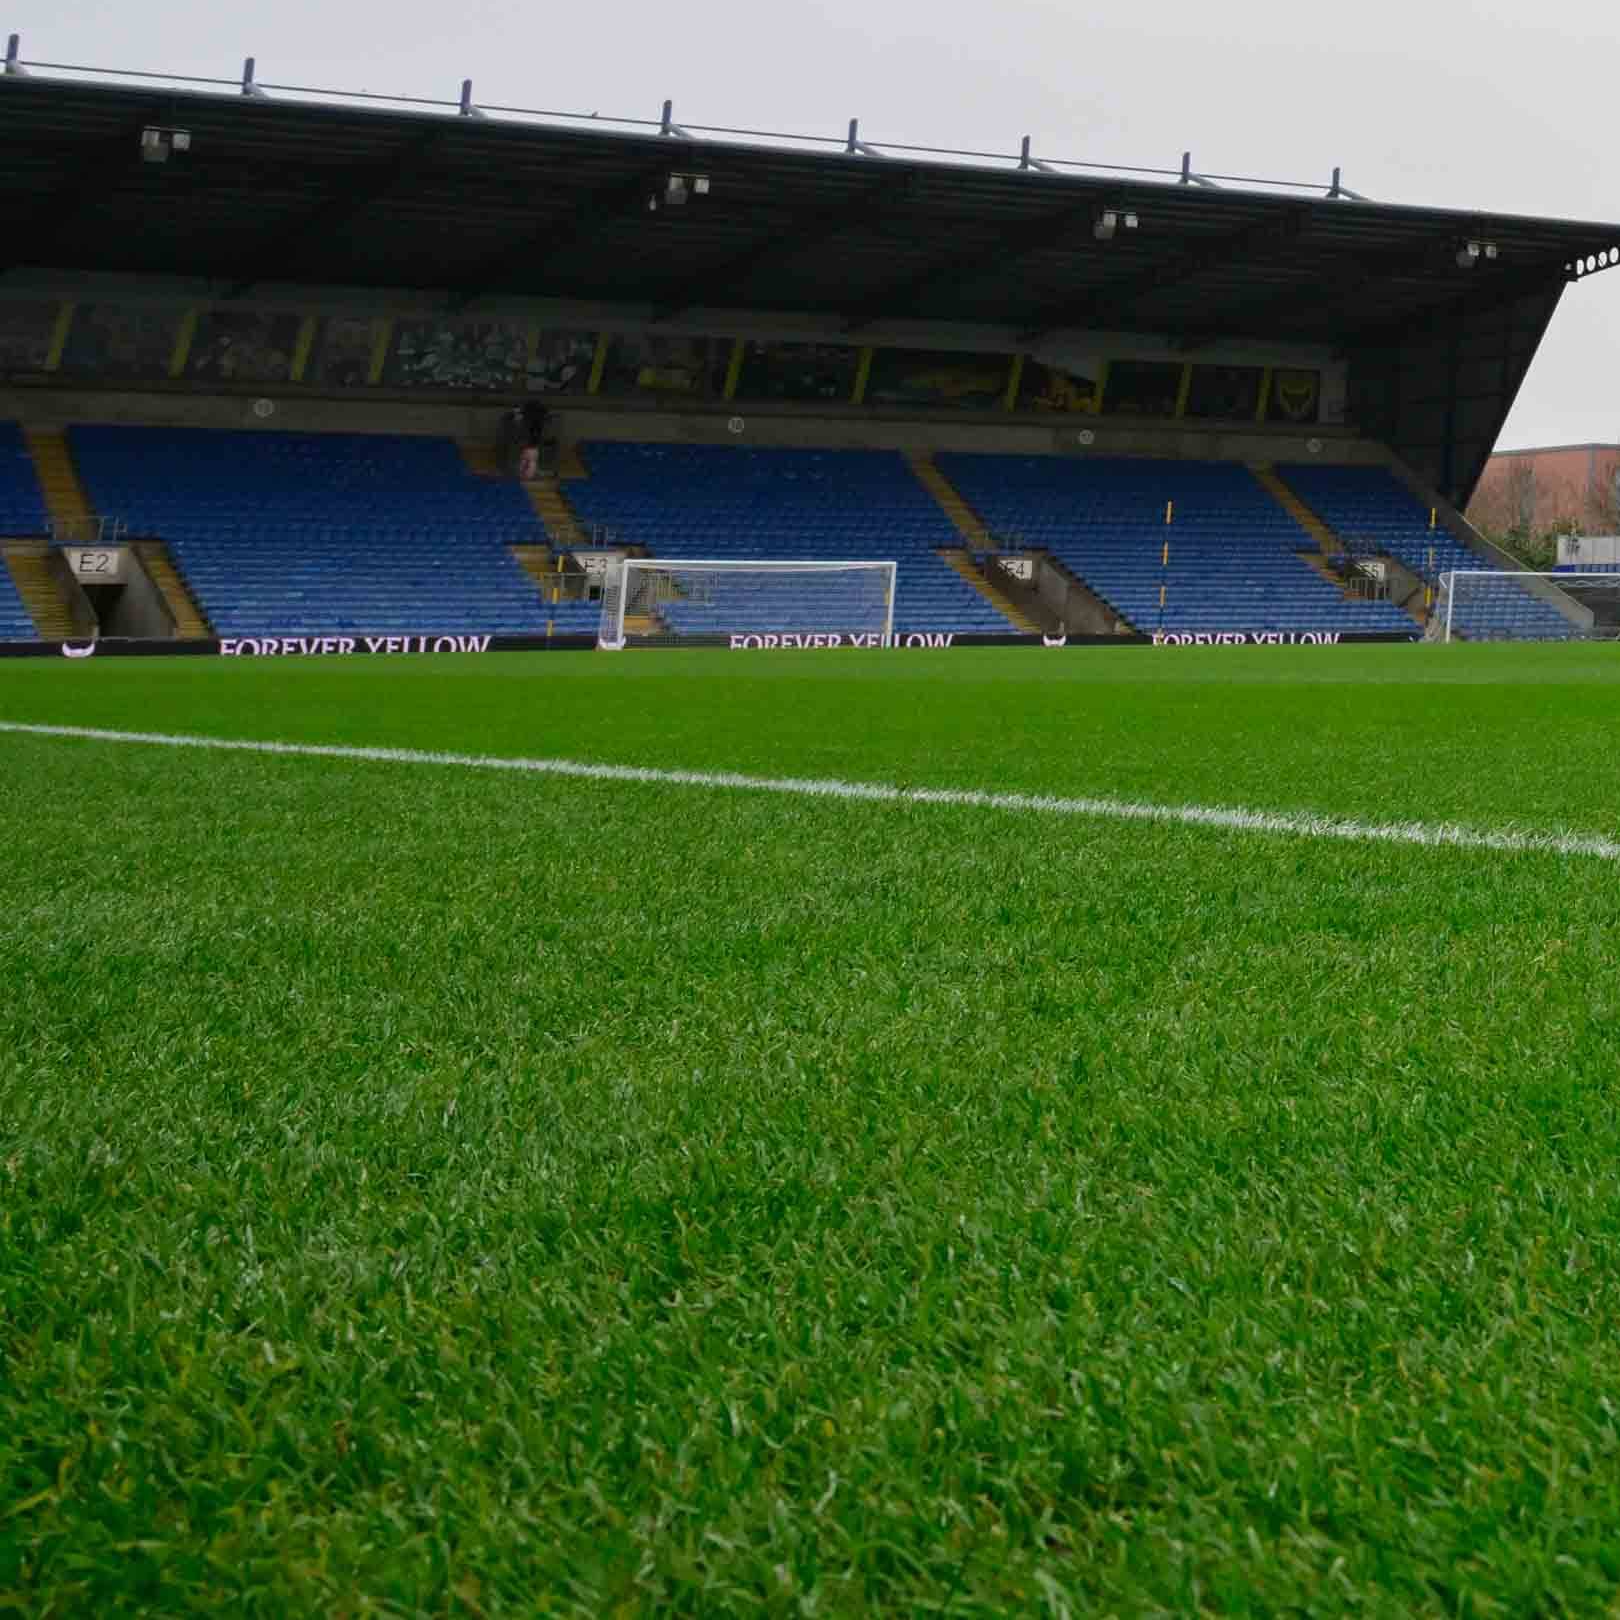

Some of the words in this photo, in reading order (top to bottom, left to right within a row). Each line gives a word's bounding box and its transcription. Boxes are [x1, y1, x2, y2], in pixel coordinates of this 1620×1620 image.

[80, 554, 109, 572] E2
[220, 638, 355, 655] FOREVER
[362, 636, 492, 653] YELLOW
[730, 636, 842, 651] FOREVER
[1253, 633, 1343, 646] YELLOW
